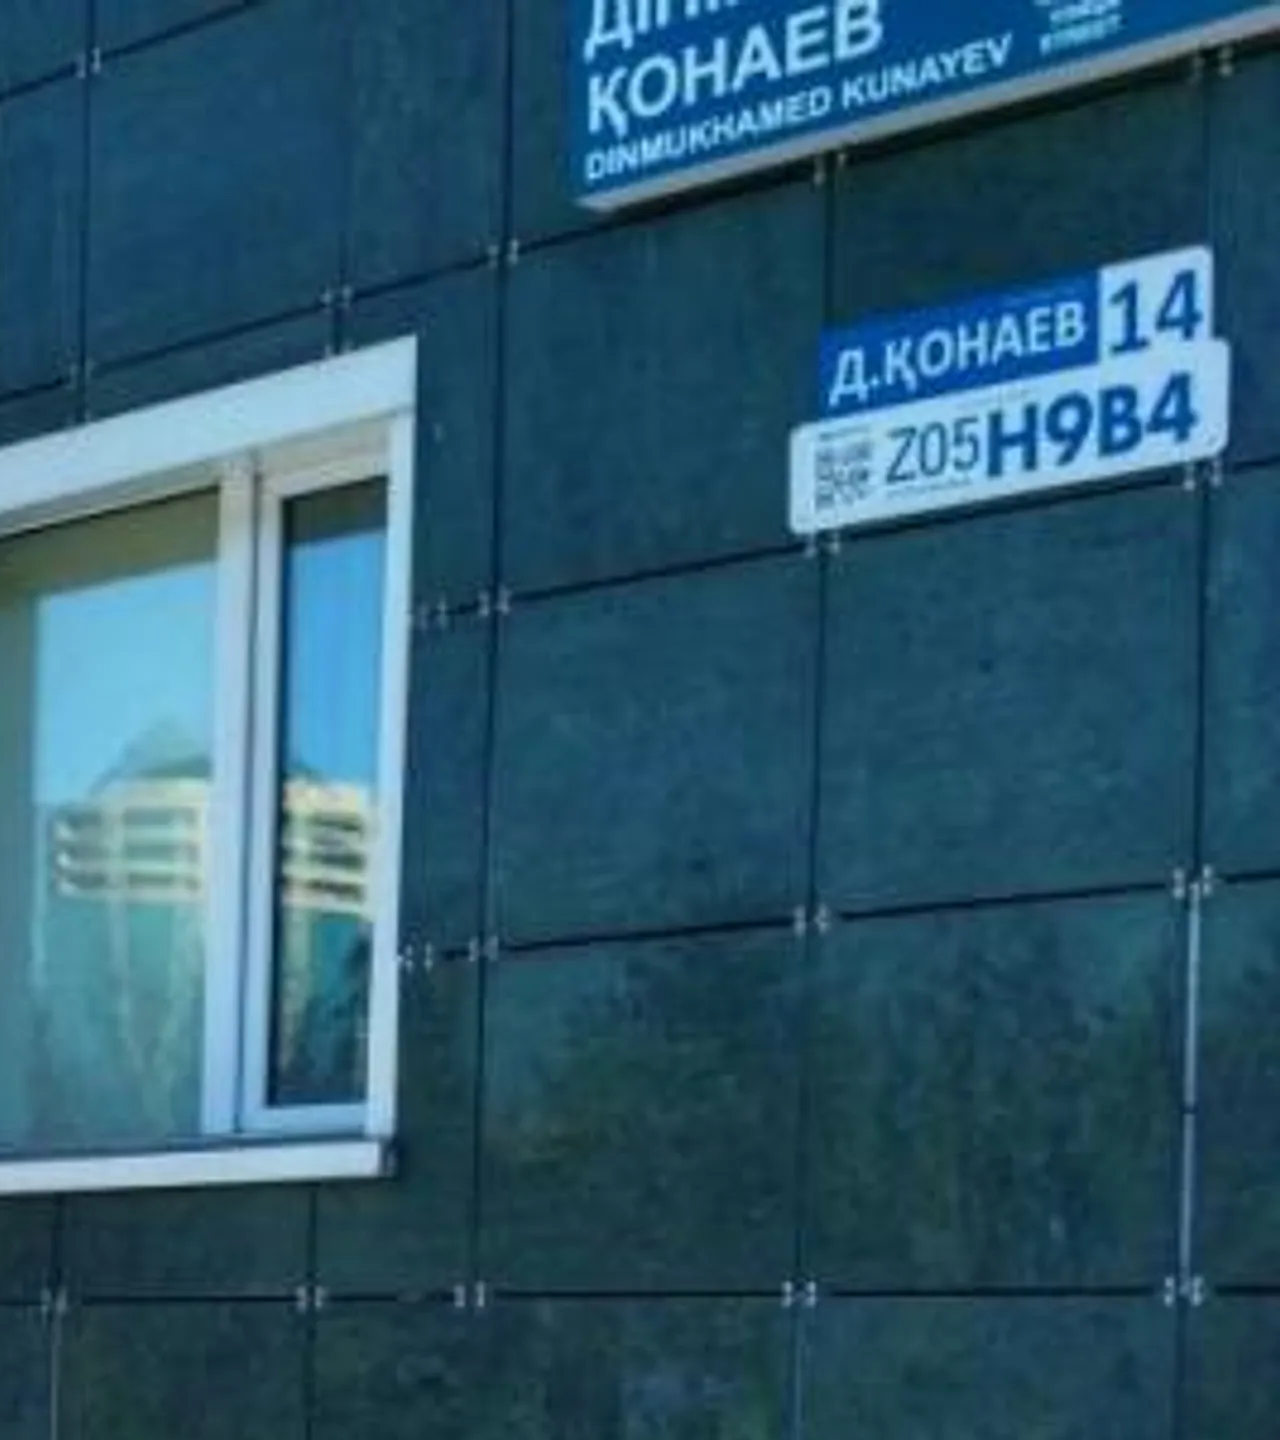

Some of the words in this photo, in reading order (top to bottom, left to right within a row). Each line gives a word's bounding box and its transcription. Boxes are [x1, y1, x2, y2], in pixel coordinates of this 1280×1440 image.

[585, 85, 833, 180] DINMUKHAMED
[842, 31, 1013, 109] KUNAYEV
[588, 0, 883, 137] ҚОНАЕВ
[830, 300, 1087, 405] Д.ҚОНАЕВ
[1108, 269, 1202, 355] 14
